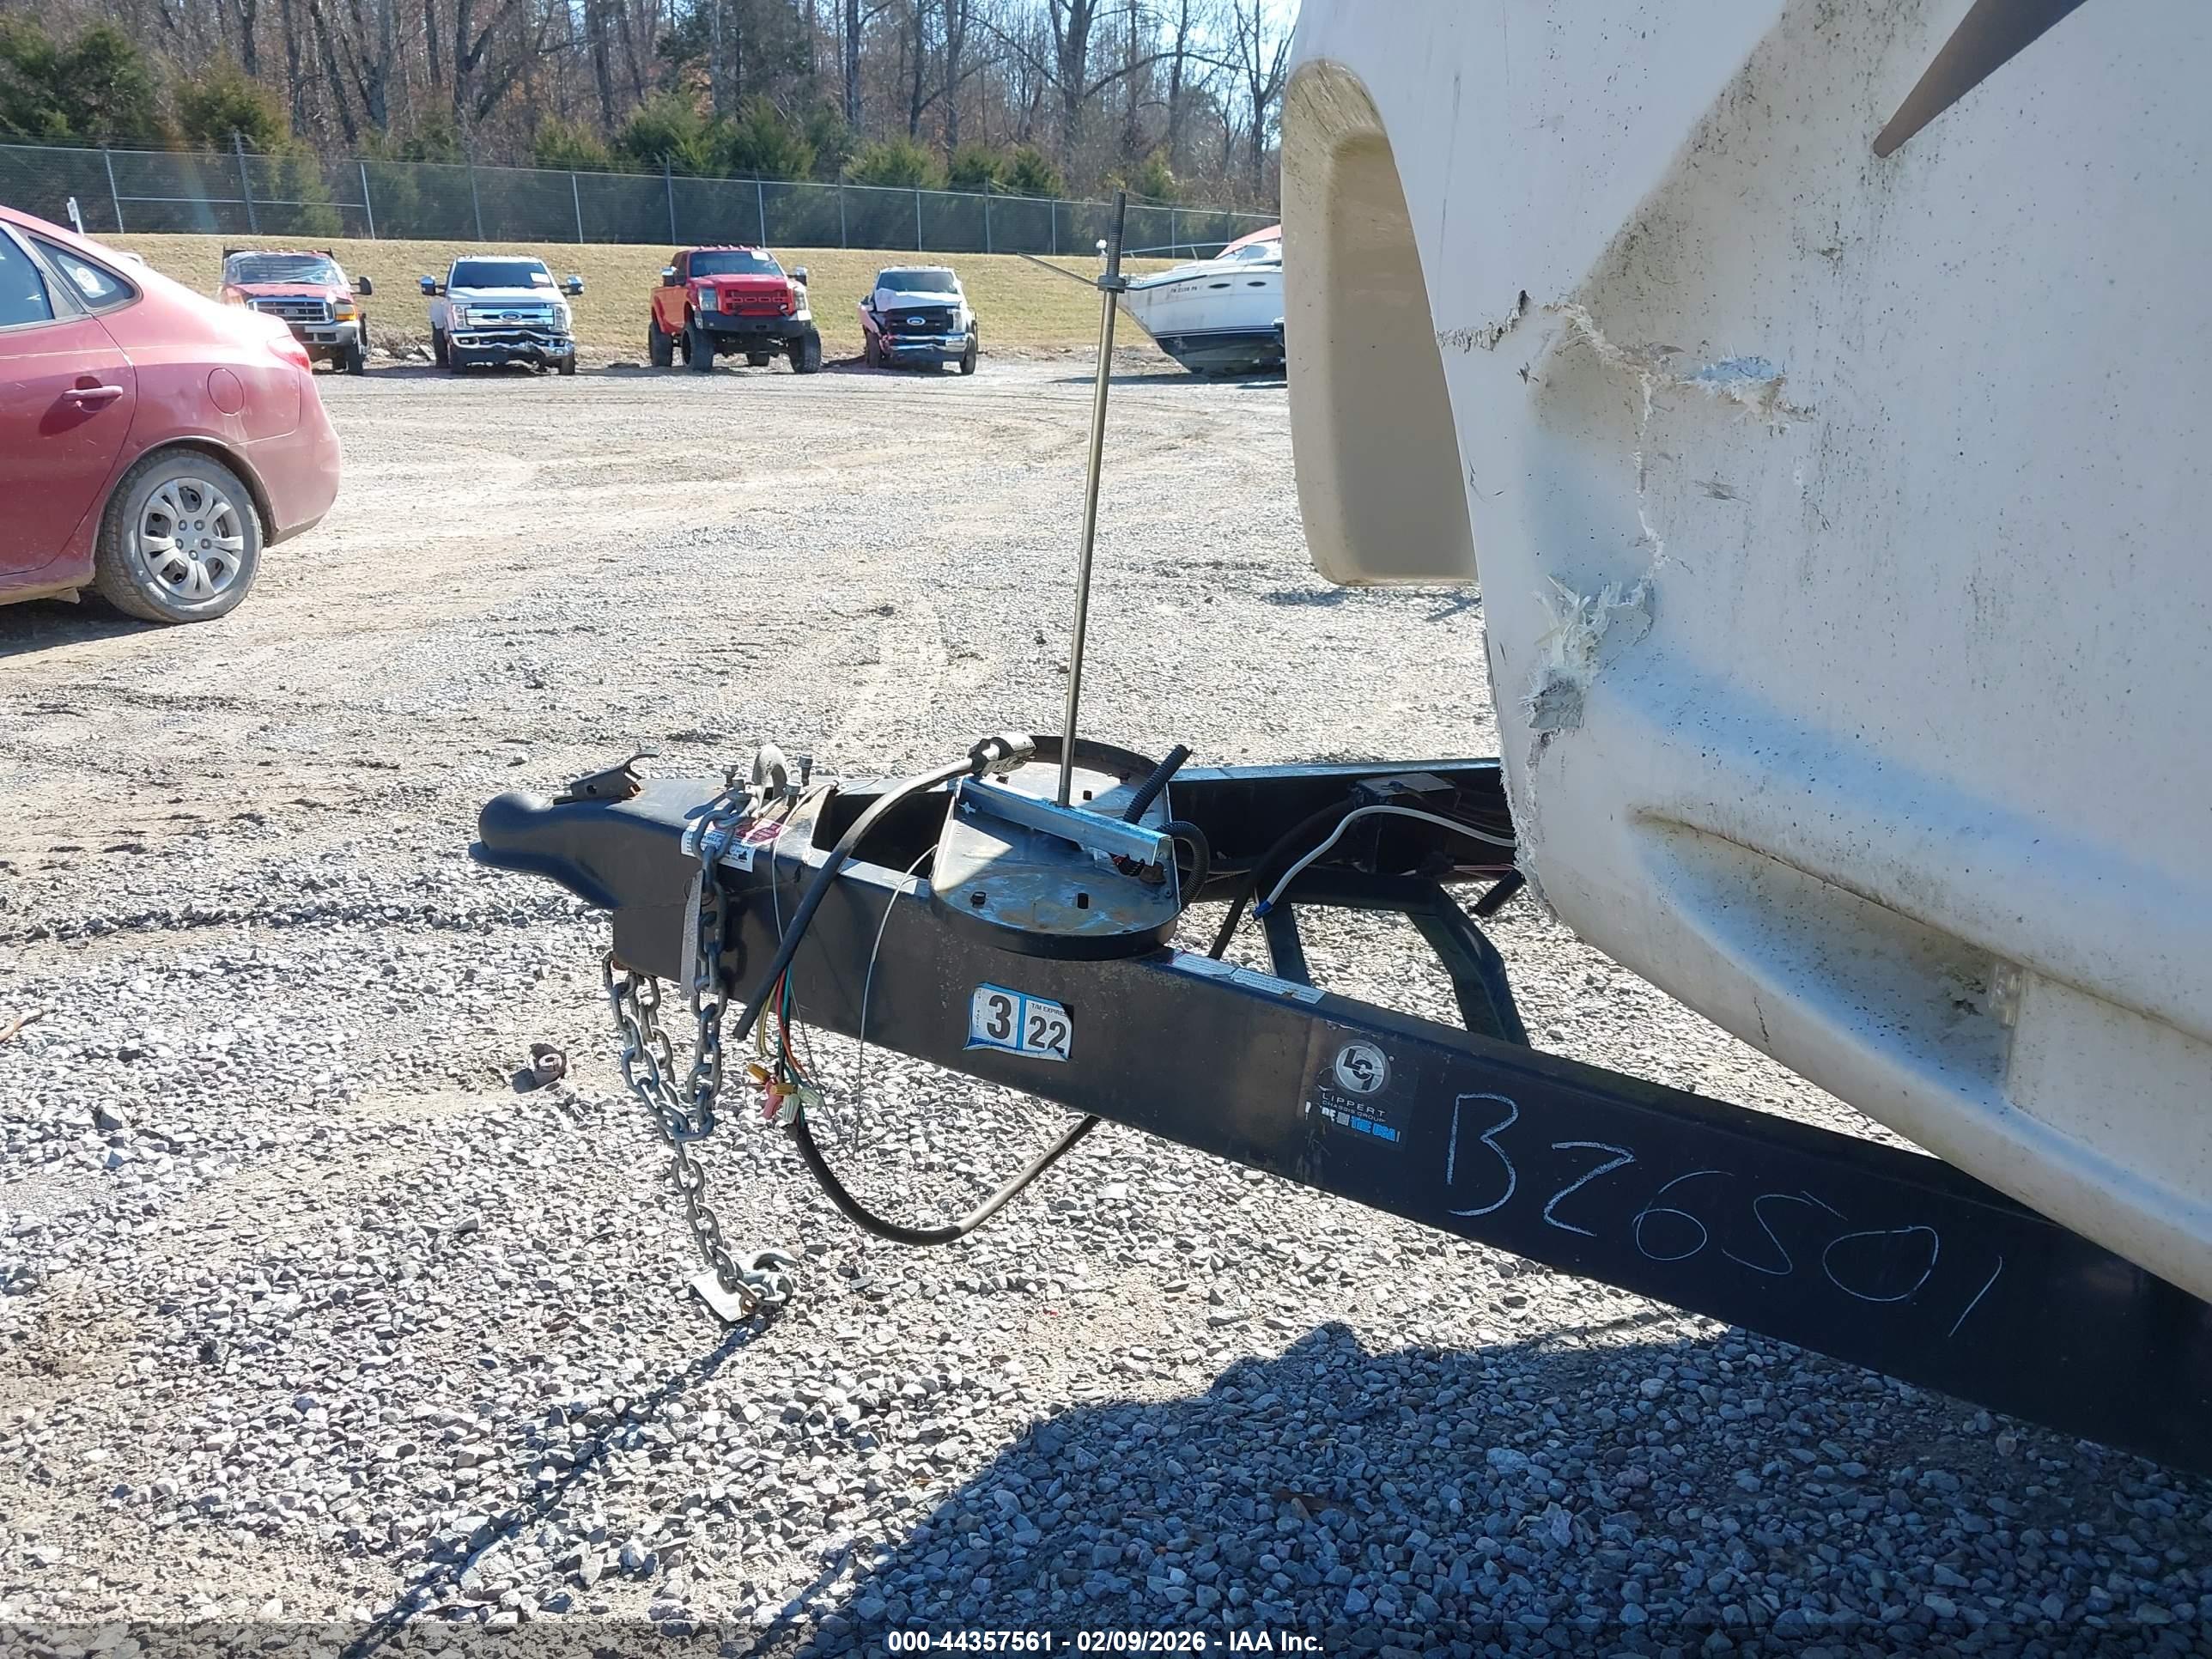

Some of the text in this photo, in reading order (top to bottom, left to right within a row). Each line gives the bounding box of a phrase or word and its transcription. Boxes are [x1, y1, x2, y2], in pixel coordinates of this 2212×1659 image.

[987, 995, 1012, 1039] 3
[1028, 1016, 1066, 1054] 22
[1322, 1092, 1386, 1117] LIPPERT
[1322, 1100, 1356, 1114] CHASSIS
[1351, 1116, 1372, 1133] THE
[1372, 1123, 1395, 1141] USA
